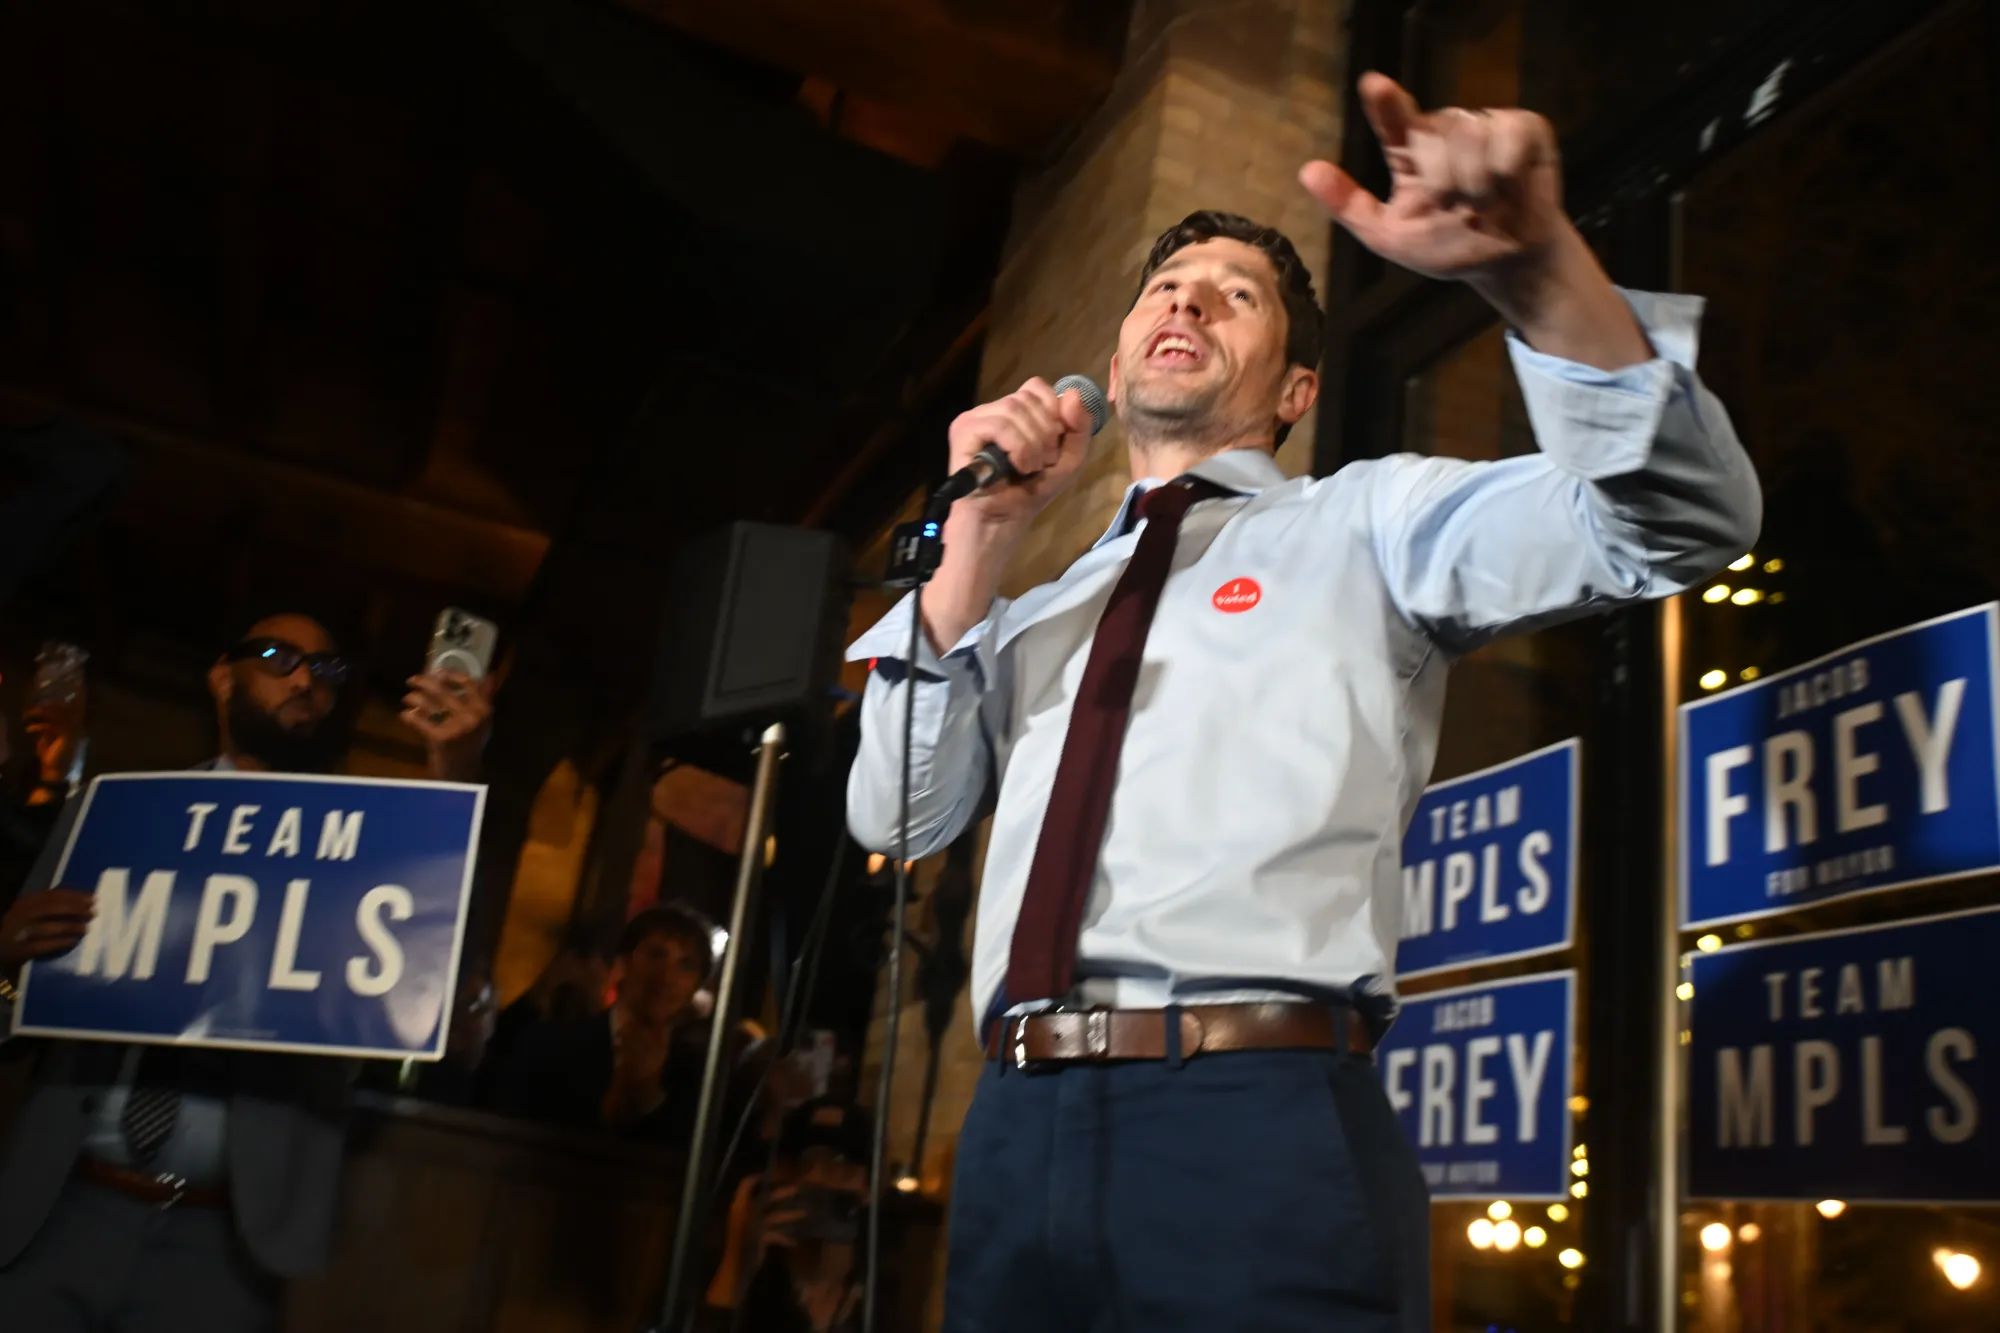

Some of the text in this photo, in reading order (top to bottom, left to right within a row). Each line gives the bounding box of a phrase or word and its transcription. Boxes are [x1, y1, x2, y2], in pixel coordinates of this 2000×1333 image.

[1777, 658, 1869, 719] JACOB
[1430, 785, 1521, 844] TEAM
[1706, 677, 1967, 867] FREY
[183, 803, 365, 861] TEAM
[1400, 830, 1552, 940] MPLS
[74, 867, 414, 997] MPLS
[1433, 995, 1495, 1033] JACOB
[1763, 955, 1916, 1023] TEAM
[1386, 1030, 1555, 1148] FREY
[1716, 1027, 1980, 1149] MPLS
